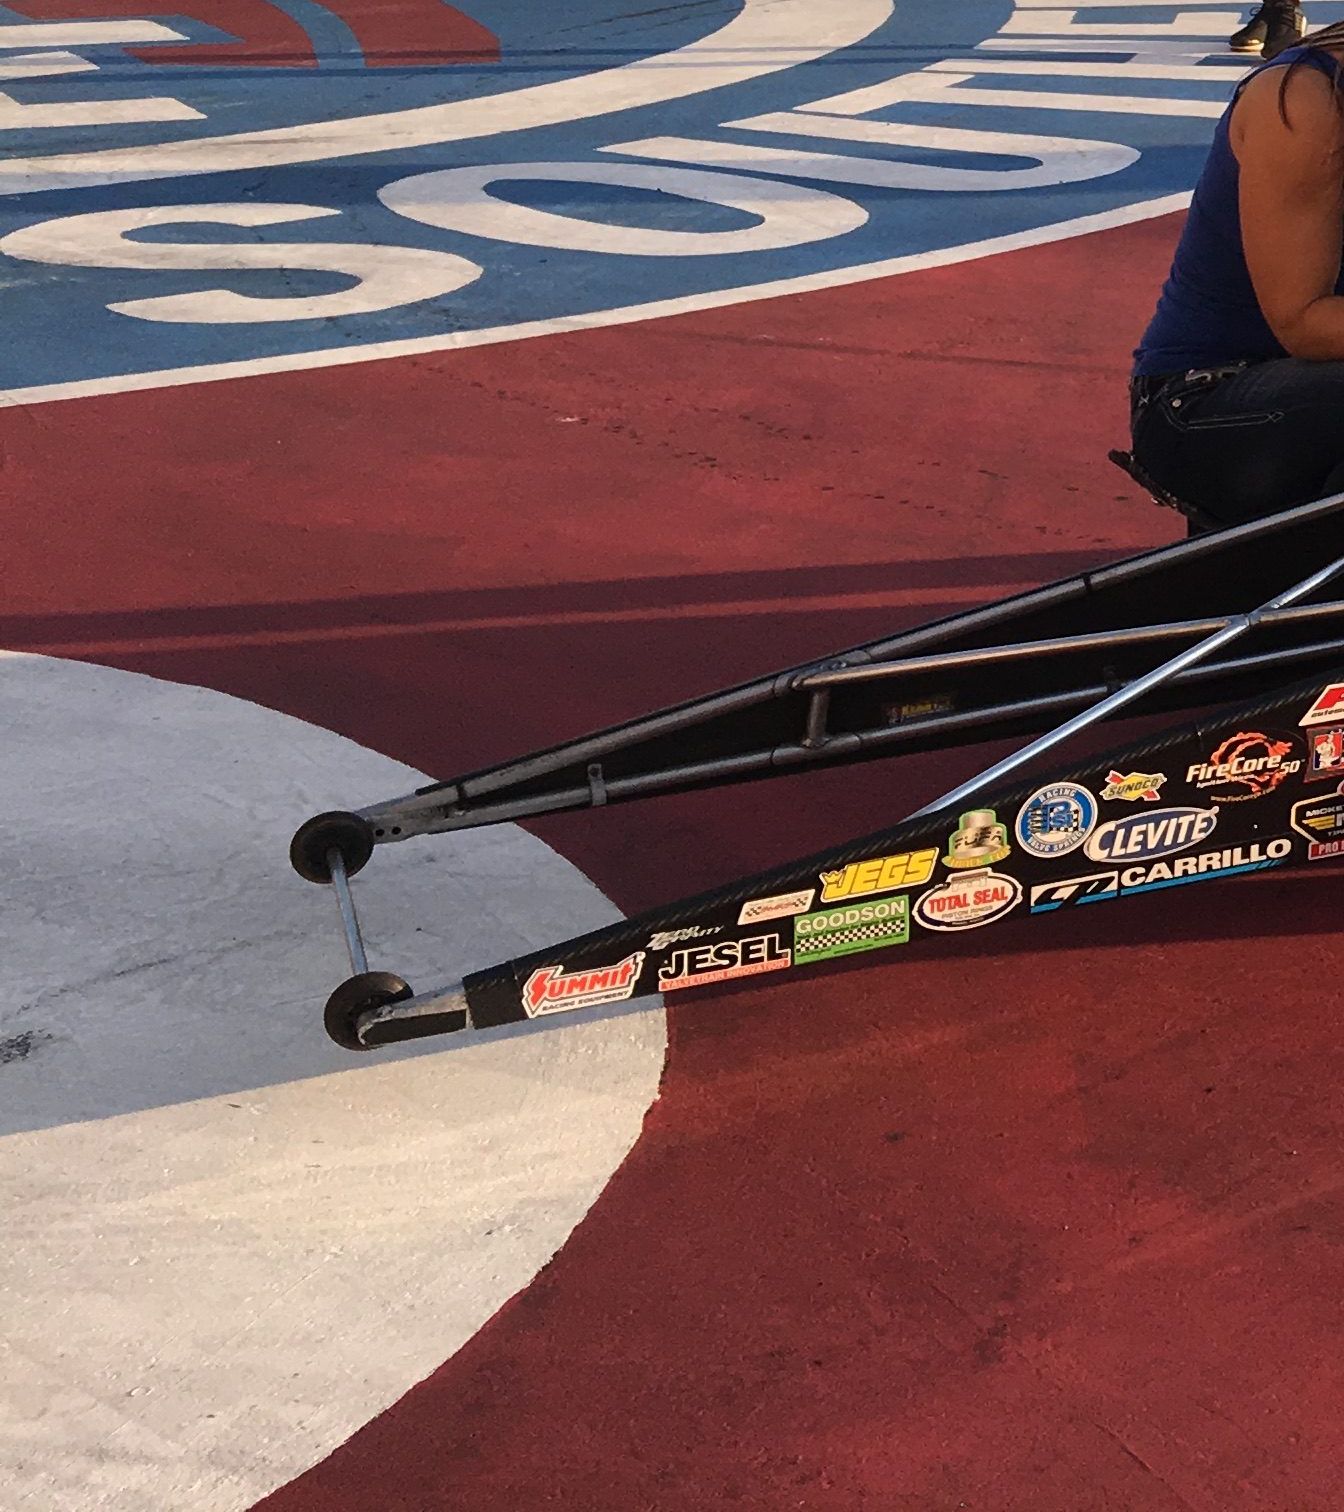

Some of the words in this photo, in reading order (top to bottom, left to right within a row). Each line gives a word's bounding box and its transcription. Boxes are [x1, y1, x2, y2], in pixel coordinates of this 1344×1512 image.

[1039, 788, 1077, 803] RACING
[1108, 778, 1160, 797] SUNOCO
[1027, 836, 1051, 852] VALVE
[1053, 827, 1086, 852] SPRINGS
[1088, 813, 1210, 861] CLEVITE
[1318, 842, 1339, 855] PRO
[824, 850, 934, 900] JEGS
[1120, 838, 1292, 888] CARRILLO
[928, 890, 970, 914] TOTAL
[972, 886, 1008, 905] SEAL
[796, 900, 905, 934] GOODSON
[660, 936, 791, 980] JESEL
[664, 971, 725, 989] VALVETRAIN
[726, 960, 786, 978] INNOVATION
[543, 998, 576, 1011] RACING
[578, 990, 630, 1006] EQUIPMENT
